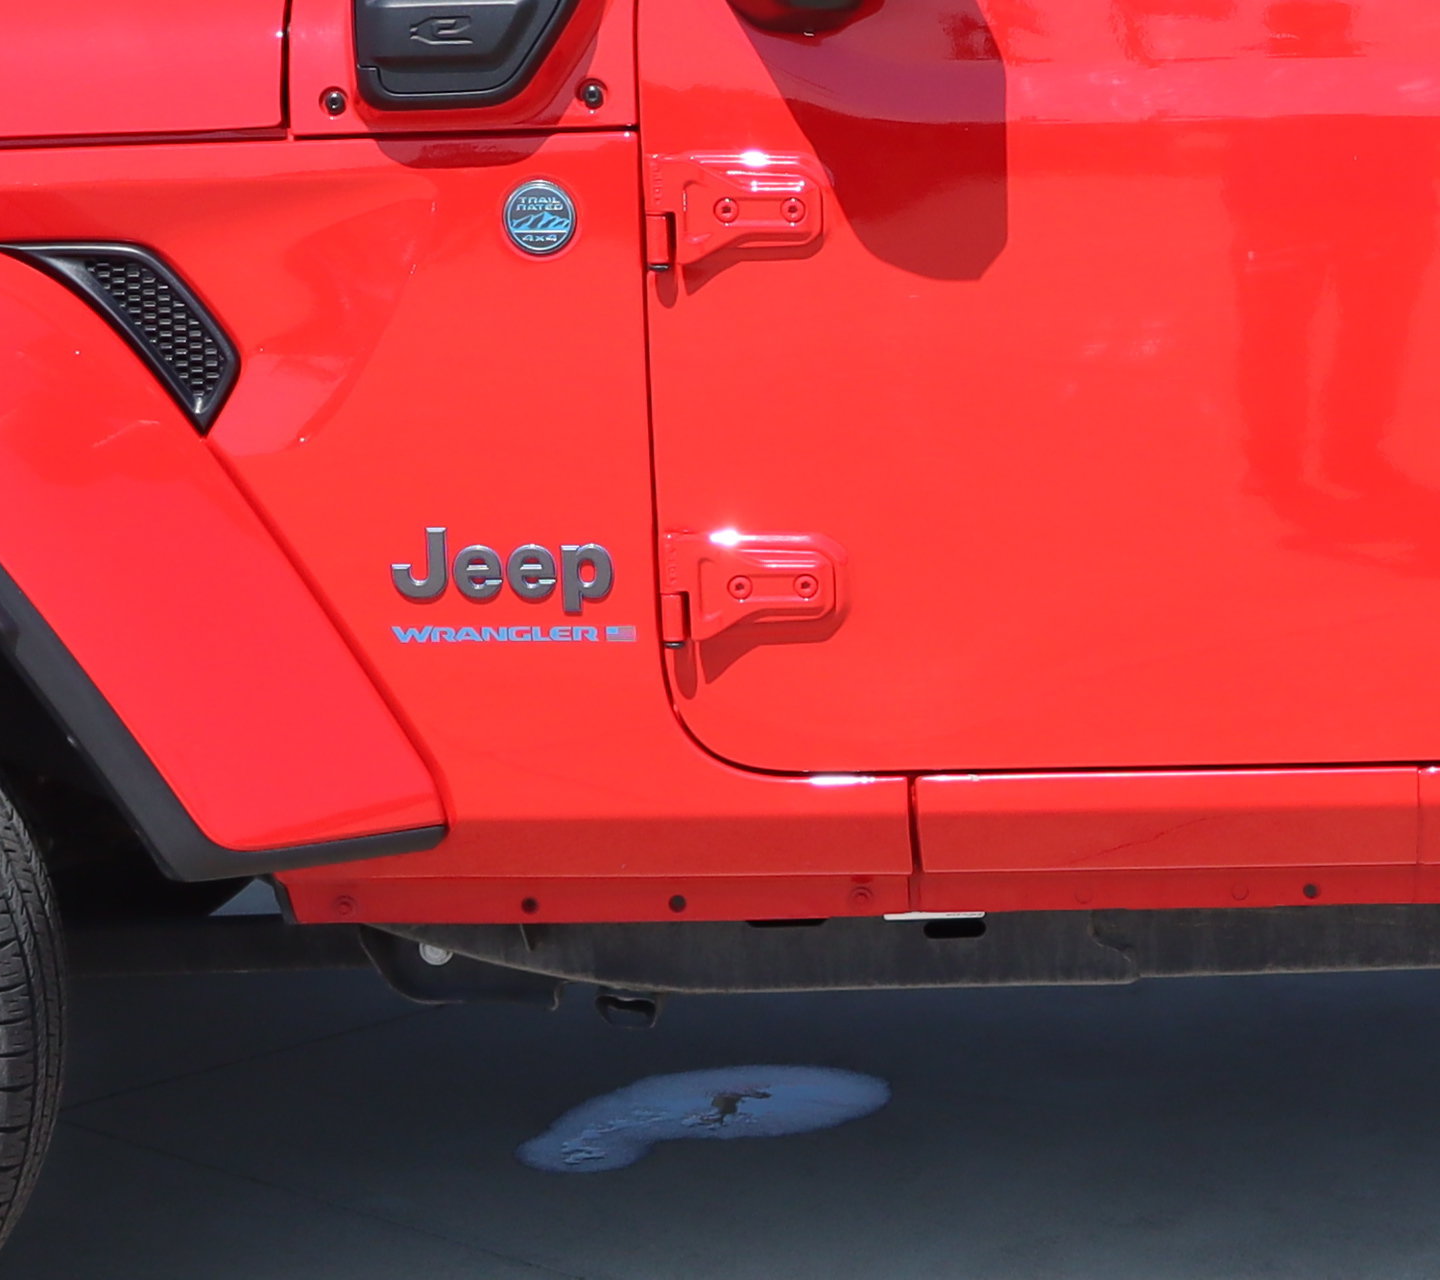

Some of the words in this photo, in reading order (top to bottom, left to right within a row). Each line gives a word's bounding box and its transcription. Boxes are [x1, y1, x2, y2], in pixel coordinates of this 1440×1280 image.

[518, 196, 561, 204] TRAIL
[391, 527, 615, 612] Jeep
[391, 625, 599, 643] WRANGLER
